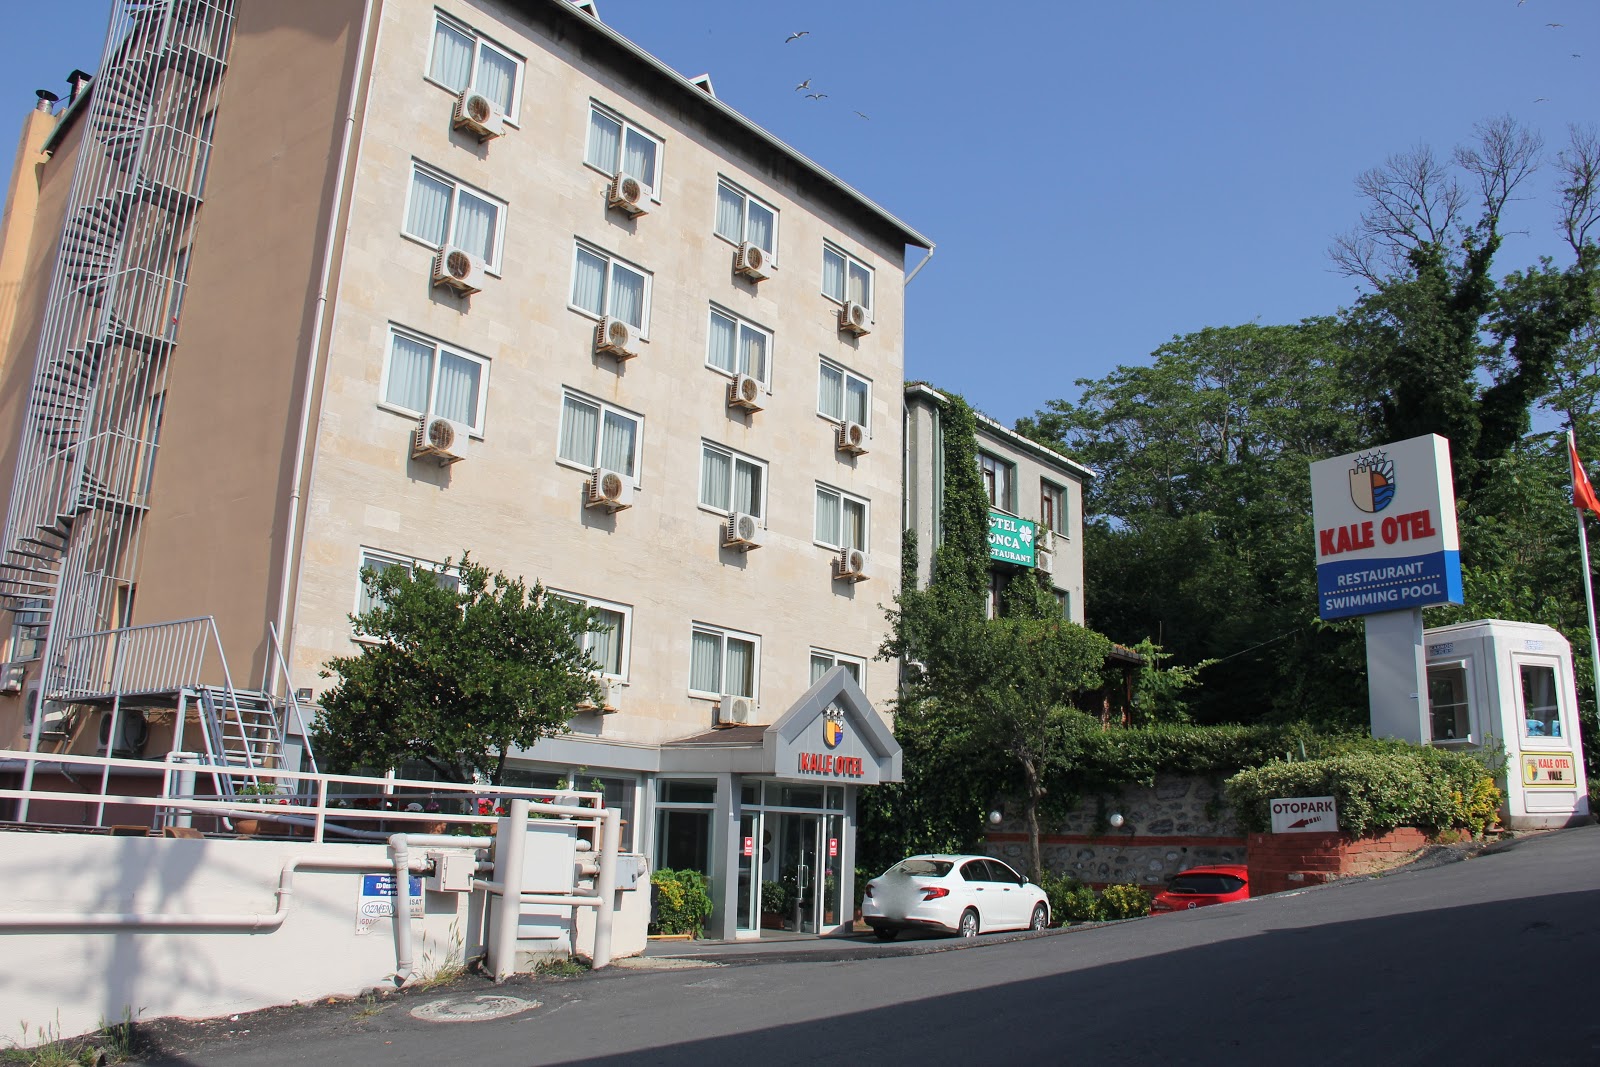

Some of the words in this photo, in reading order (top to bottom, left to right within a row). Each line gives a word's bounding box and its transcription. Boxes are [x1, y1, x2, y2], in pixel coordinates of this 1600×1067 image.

[988, 516, 1017, 532] OTEL
[987, 533, 1020, 549] ONCA
[1319, 521, 1375, 556] KALE
[1381, 510, 1436, 545] OTEL
[990, 548, 1031, 563] STAURANT
[1337, 561, 1424, 587] RESTAURANT
[1325, 588, 1398, 611] SWIMMING
[1401, 582, 1441, 600] POOL
[800, 752, 833, 773] KALE
[835, 756, 864, 775] OTEL
[1538, 758, 1554, 768] KALE
[1555, 759, 1570, 769] OTEL
[1547, 771, 1563, 781] VALE
[1273, 801, 1333, 814] OTOPARK
